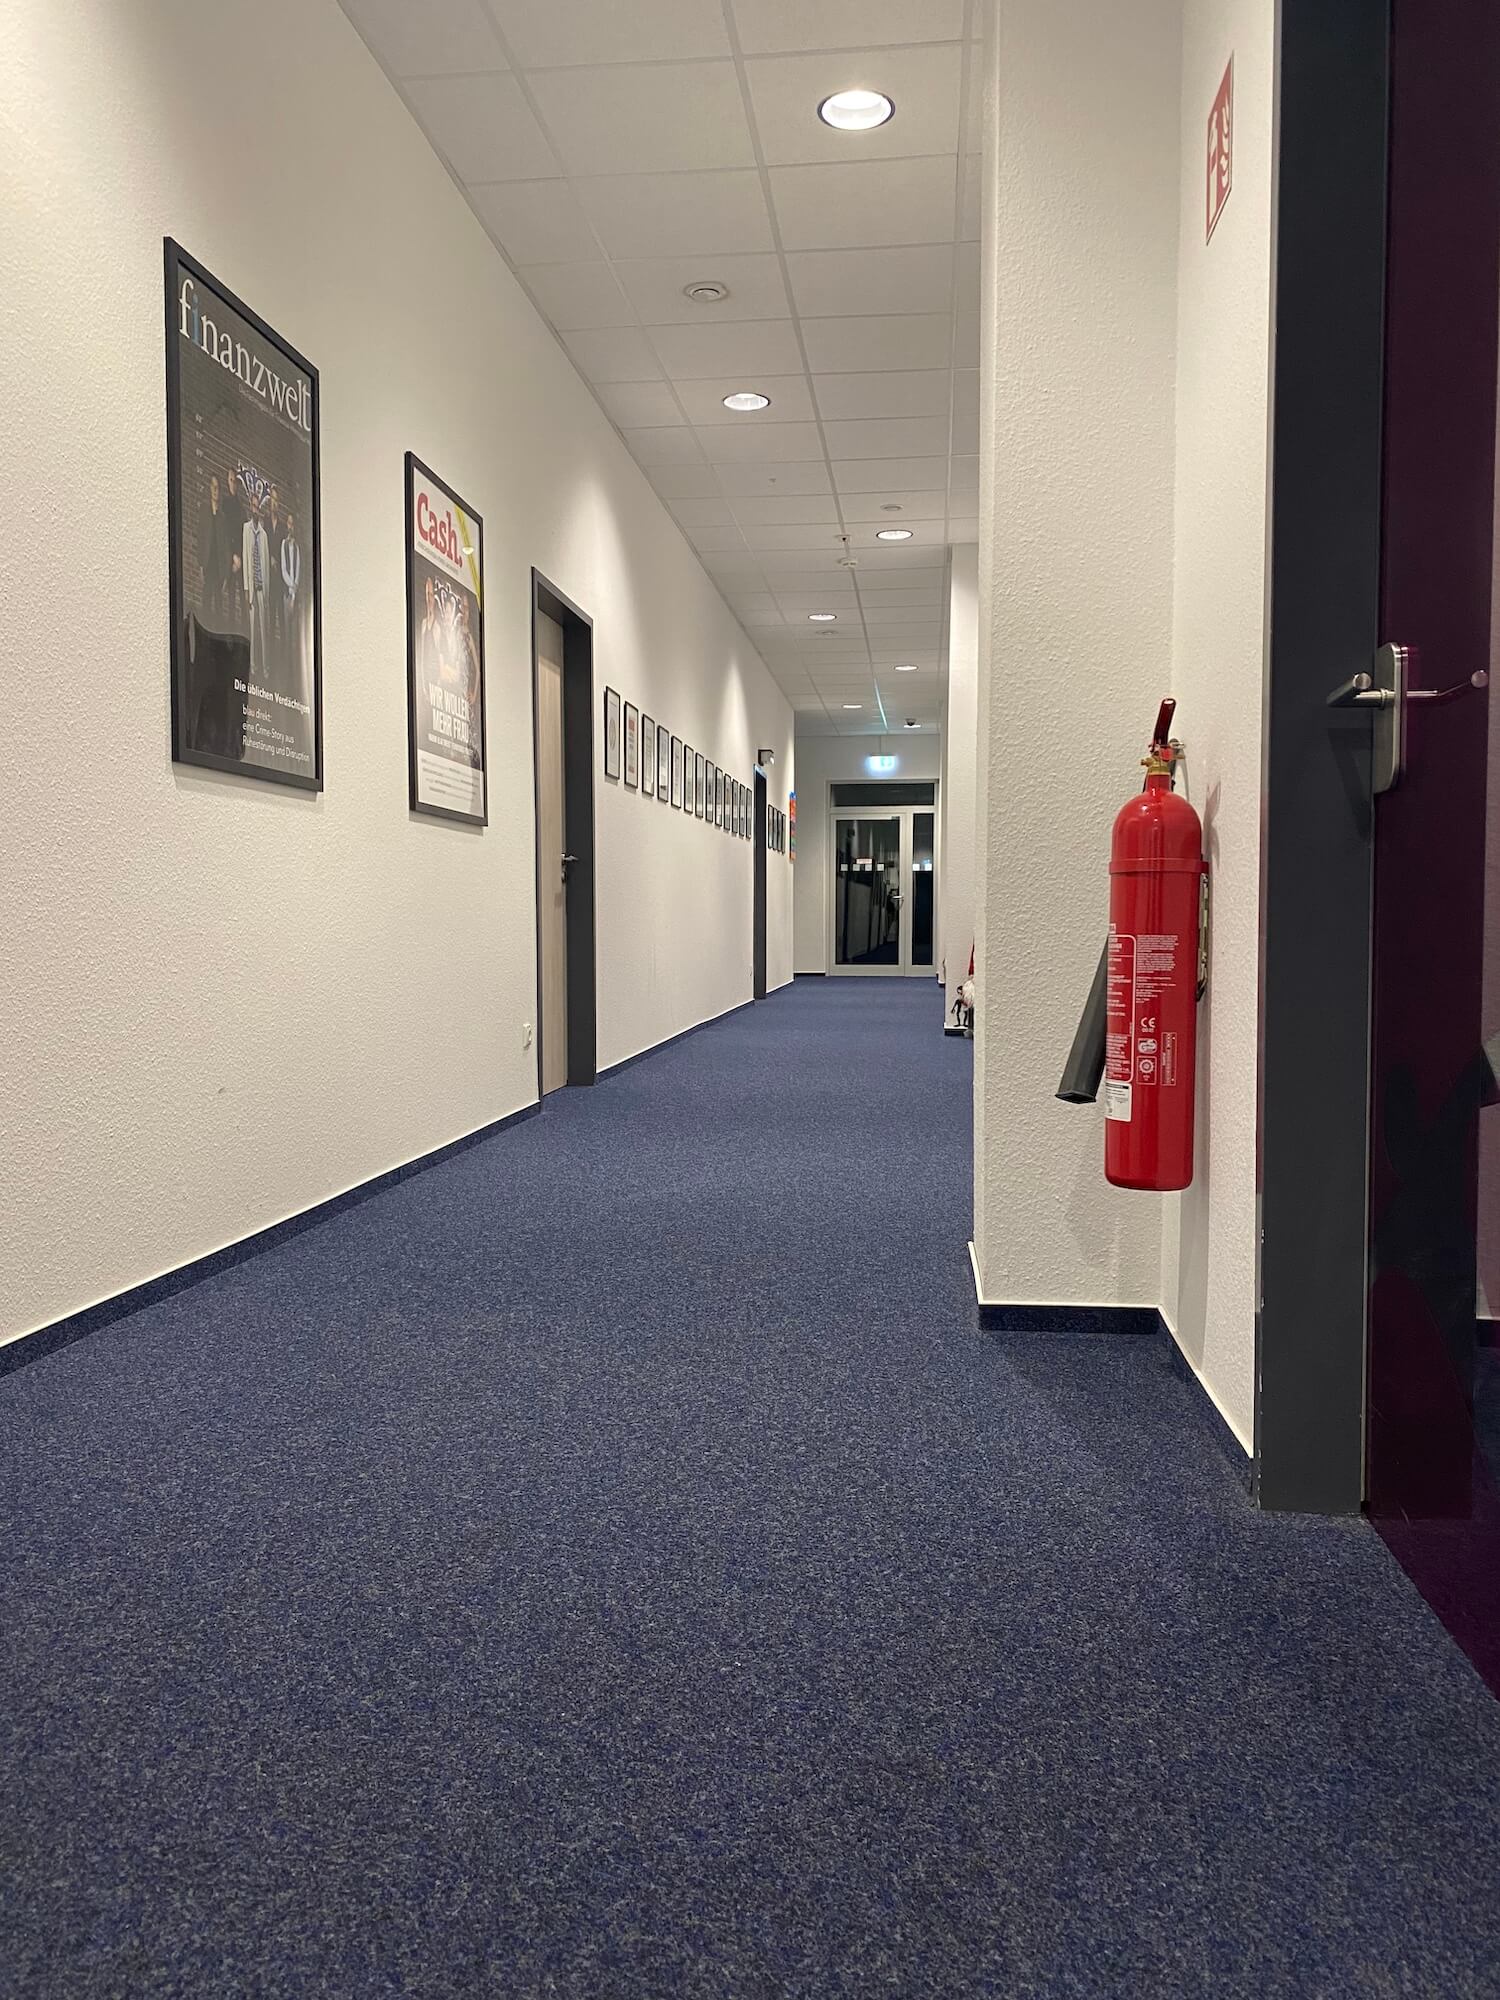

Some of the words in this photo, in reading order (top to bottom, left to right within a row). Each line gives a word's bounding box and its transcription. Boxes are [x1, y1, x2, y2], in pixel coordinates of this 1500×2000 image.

[178, 278, 312, 432] finanzwelt
[234, 678, 247, 692] Die
[247, 683, 274, 701] üblichen
[242, 721, 255, 733] eine
[275, 746, 286, 756] und
